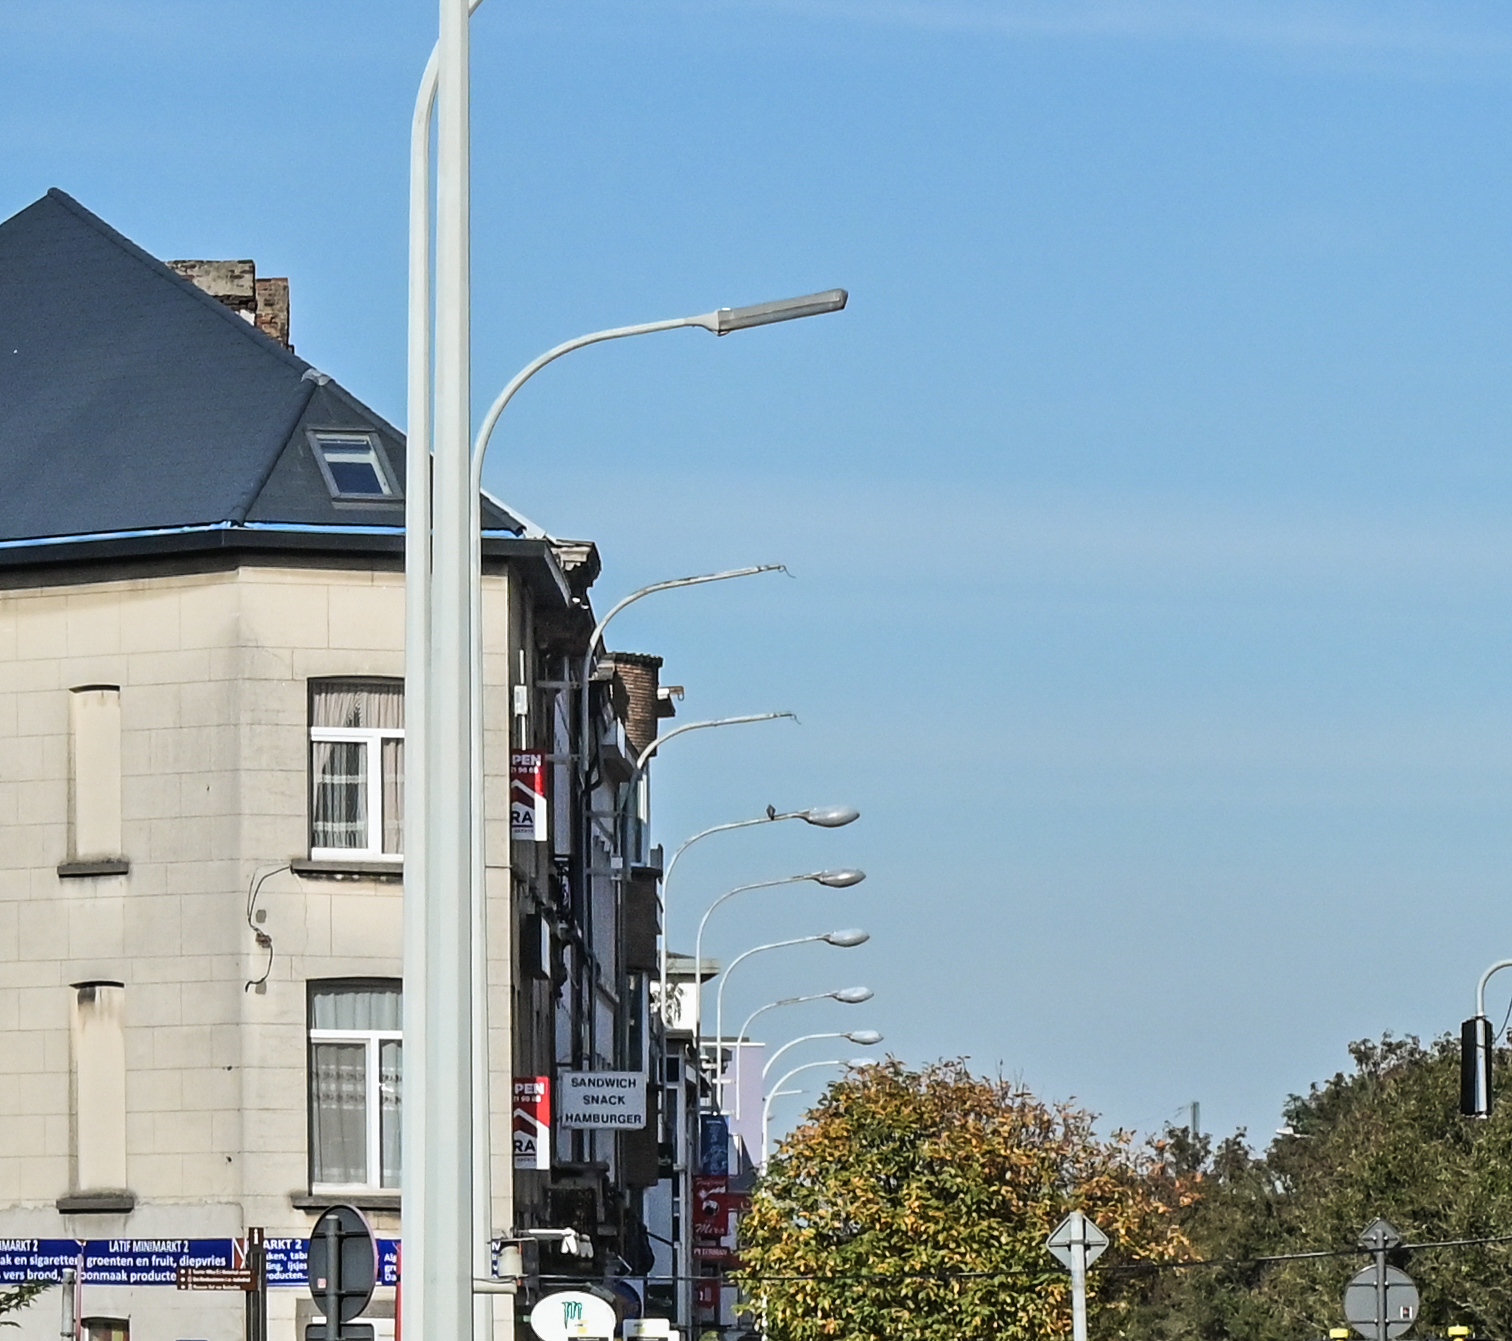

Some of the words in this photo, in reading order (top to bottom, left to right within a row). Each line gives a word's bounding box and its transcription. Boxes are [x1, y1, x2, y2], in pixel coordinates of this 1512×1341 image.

[514, 1082, 545, 1094] PEN
[571, 1077, 637, 1088] SANDWICH
[583, 1095, 626, 1105] SNACK
[565, 1114, 642, 1124] HAMBURGER
[514, 1140, 536, 1152] RA
[109, 1240, 131, 1253] LATIF
[132, 1240, 181, 1253] MINIMARKT
[182, 1240, 190, 1253] 2
[263, 1239, 292, 1249] ARKT
[294, 1239, 302, 1249] 2
[14, 1256, 28, 1266] en
[86, 1255, 133, 1268] groenten
[135, 1256, 149, 1267] en
[151, 1254, 177, 1268] fruit,
[179, 1254, 227, 1270] diepvries
[2, 1271, 26, 1281] vers
[26, 1268, 61, 1282] brood,
[130, 1270, 176, 1284] producte
